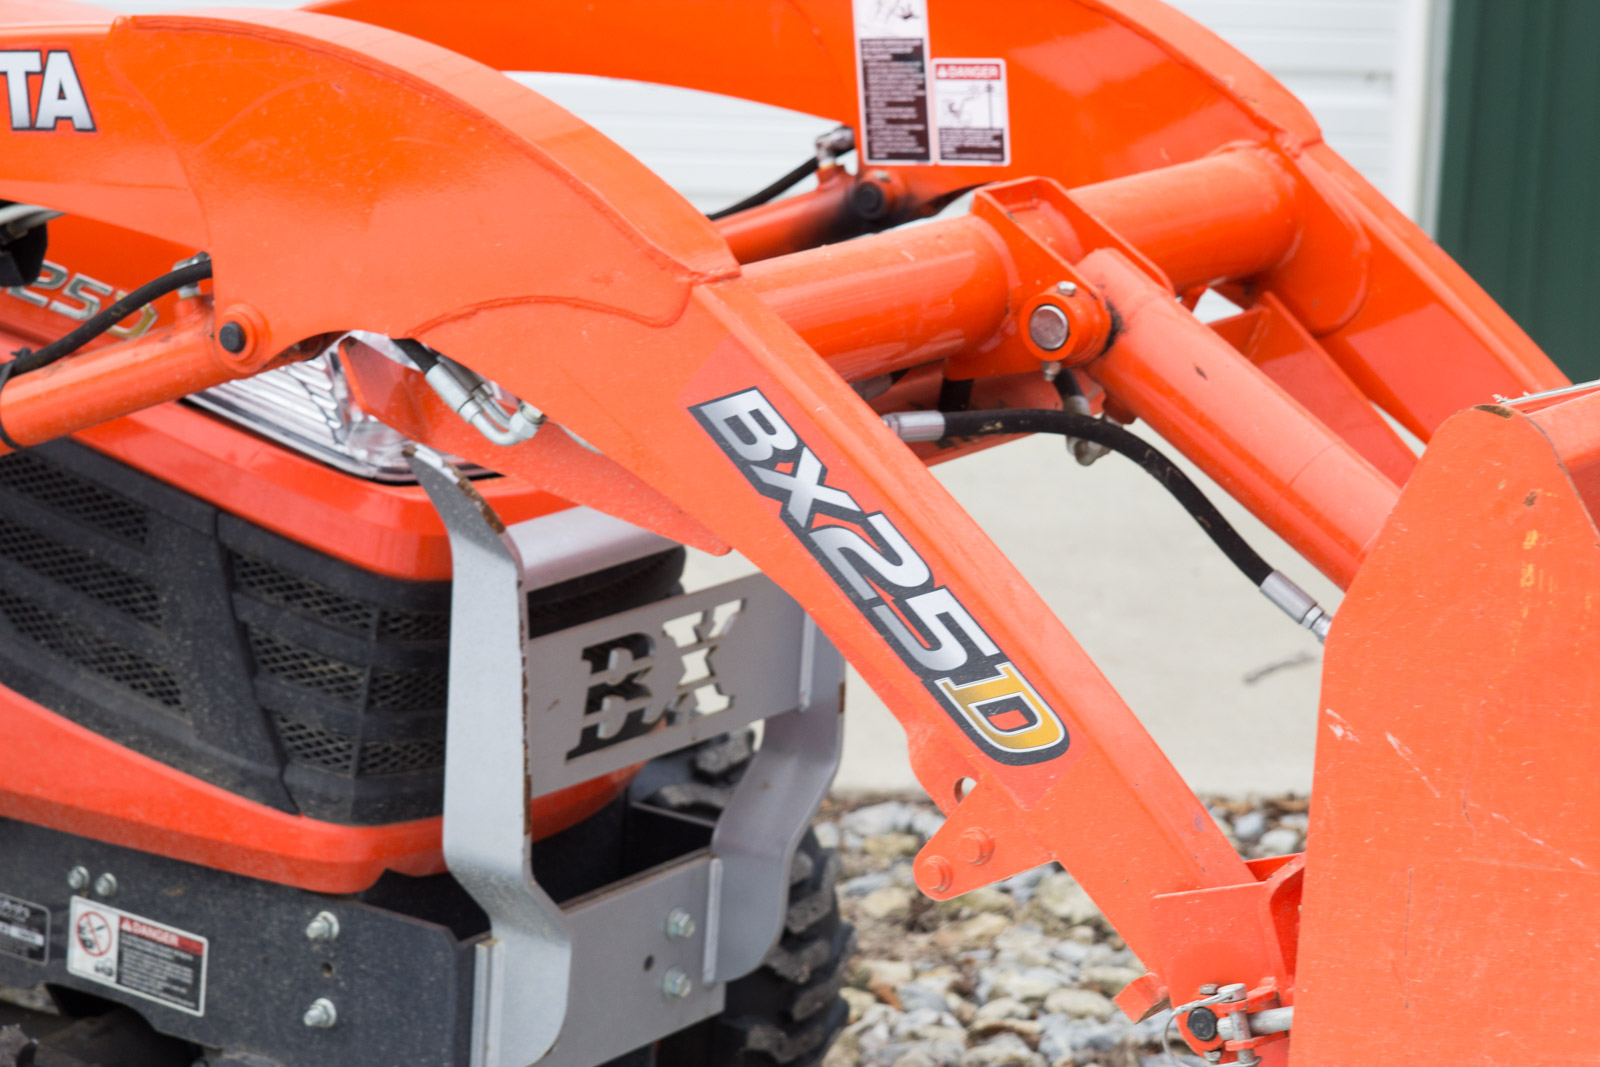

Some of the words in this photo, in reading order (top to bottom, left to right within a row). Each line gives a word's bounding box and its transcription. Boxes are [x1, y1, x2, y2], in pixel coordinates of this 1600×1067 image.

[947, 65, 998, 79] DANGER
[692, 386, 1068, 760] BX25D
[566, 599, 747, 765] BX
[132, 920, 179, 948] DANGER
